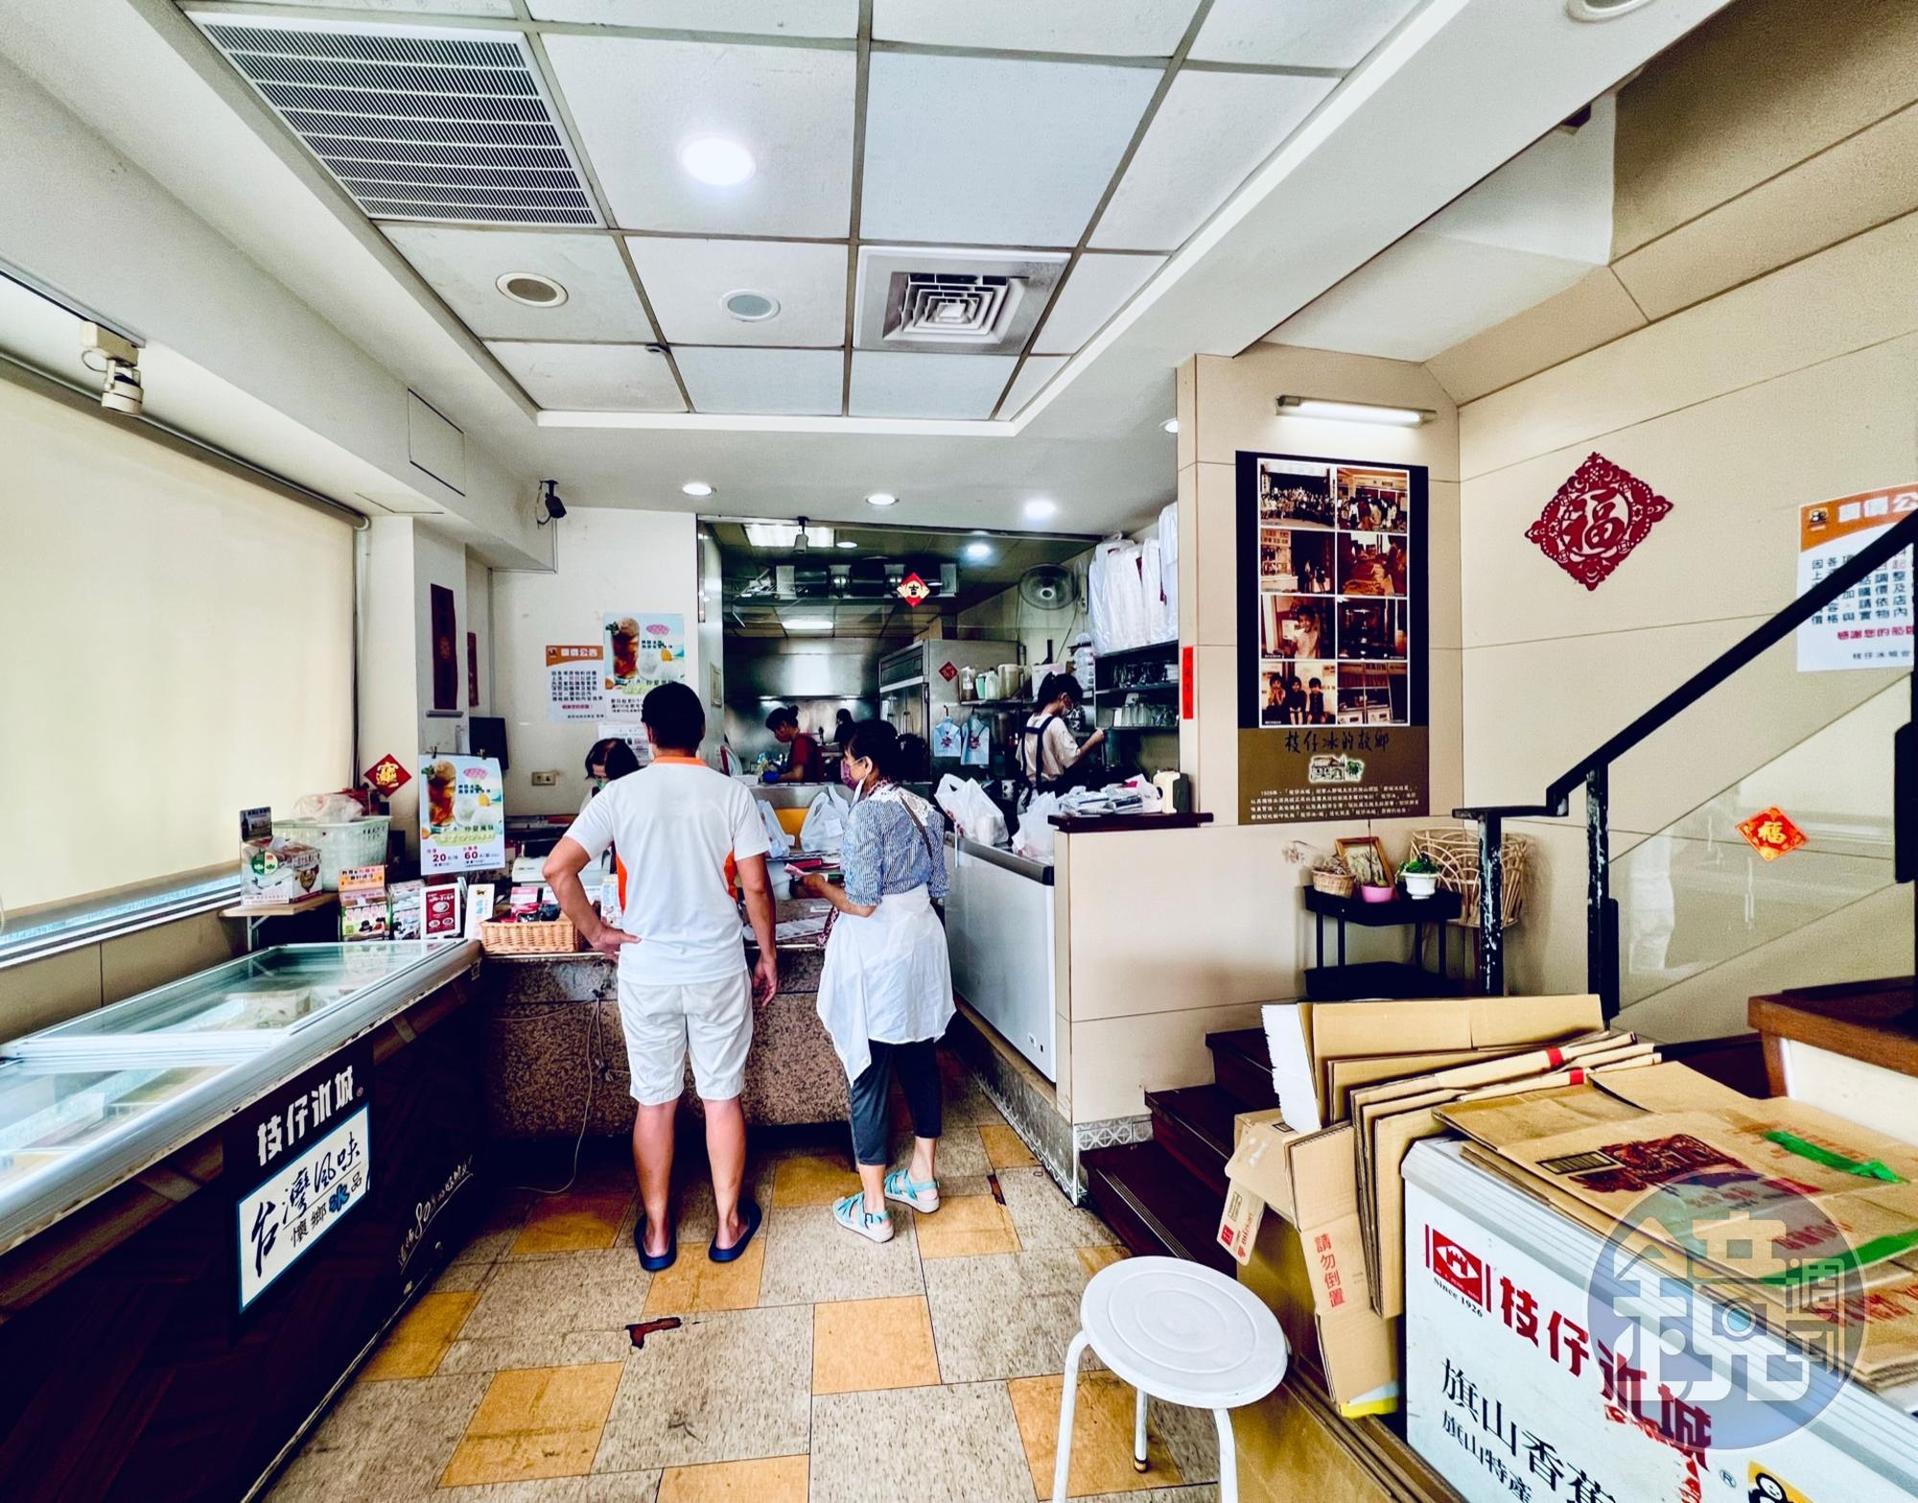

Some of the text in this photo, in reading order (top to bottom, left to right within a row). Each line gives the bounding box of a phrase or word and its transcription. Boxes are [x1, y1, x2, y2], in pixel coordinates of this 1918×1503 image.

[1563, 486, 1626, 551] 福
[1285, 729, 1389, 754] 枝仔冰的故鄉
[257, 1065, 354, 1167] 枝仔冰城
[250, 1131, 361, 1279] 台灣風味
[290, 1170, 363, 1248] 懷鄉冰品
[1314, 1233, 1346, 1308] 請勿倒置
[1433, 1277, 1459, 1299] Since
